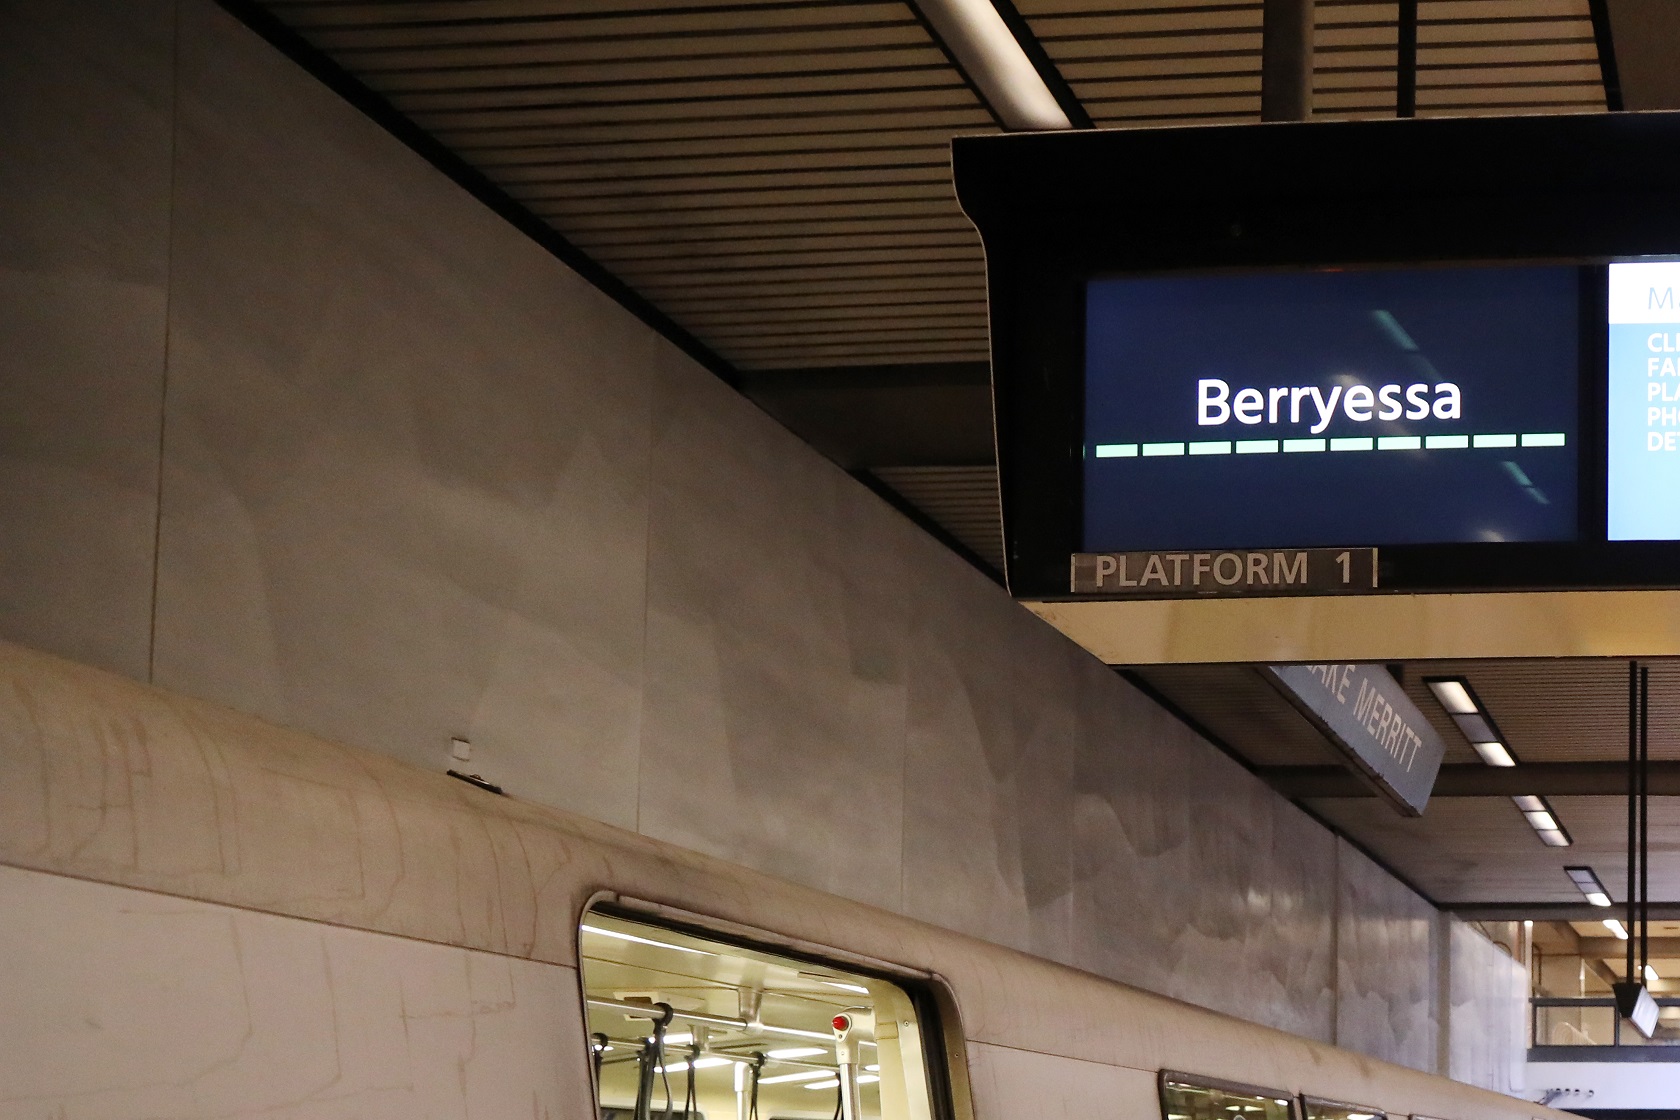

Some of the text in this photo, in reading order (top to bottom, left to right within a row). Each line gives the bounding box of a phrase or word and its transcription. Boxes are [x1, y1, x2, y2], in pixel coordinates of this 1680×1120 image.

[1197, 379, 1462, 433] Berryessa
[1096, 551, 1352, 588] PLATFORM 1
[1353, 677, 1422, 773] MERRITT
